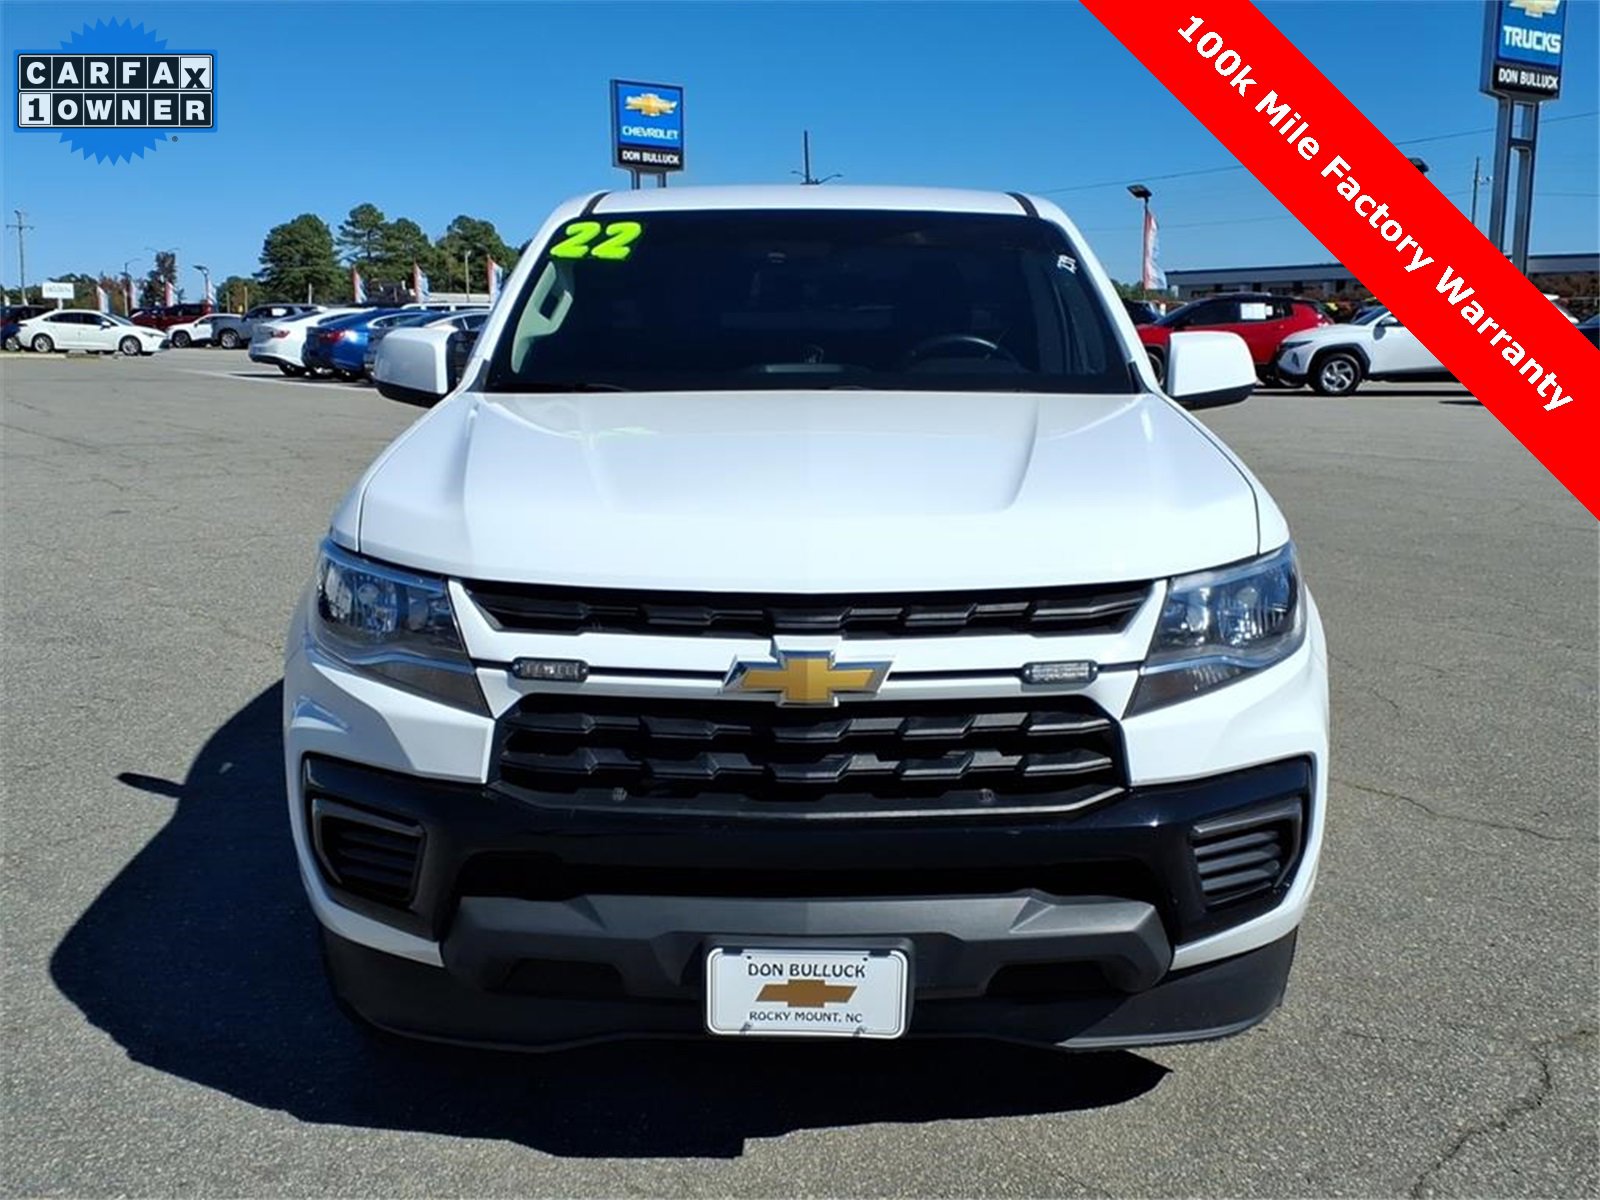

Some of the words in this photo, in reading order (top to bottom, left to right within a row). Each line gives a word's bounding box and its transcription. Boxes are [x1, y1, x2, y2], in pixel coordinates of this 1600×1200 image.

[1503, 25, 1561, 54] TRUCKS
[1498, 68, 1518, 84] DON
[1520, 71, 1558, 90] BULLUCK
[622, 126, 678, 140] CHEVROLET
[622, 150, 640, 161] DON
[550, 221, 642, 260] 22
[748, 963, 783, 977] DON
[789, 964, 866, 978] BULLUCK
[749, 1011, 791, 1022] ROCKY
[794, 1012, 842, 1023] MOUNT,
[846, 1013, 863, 1023] NC
